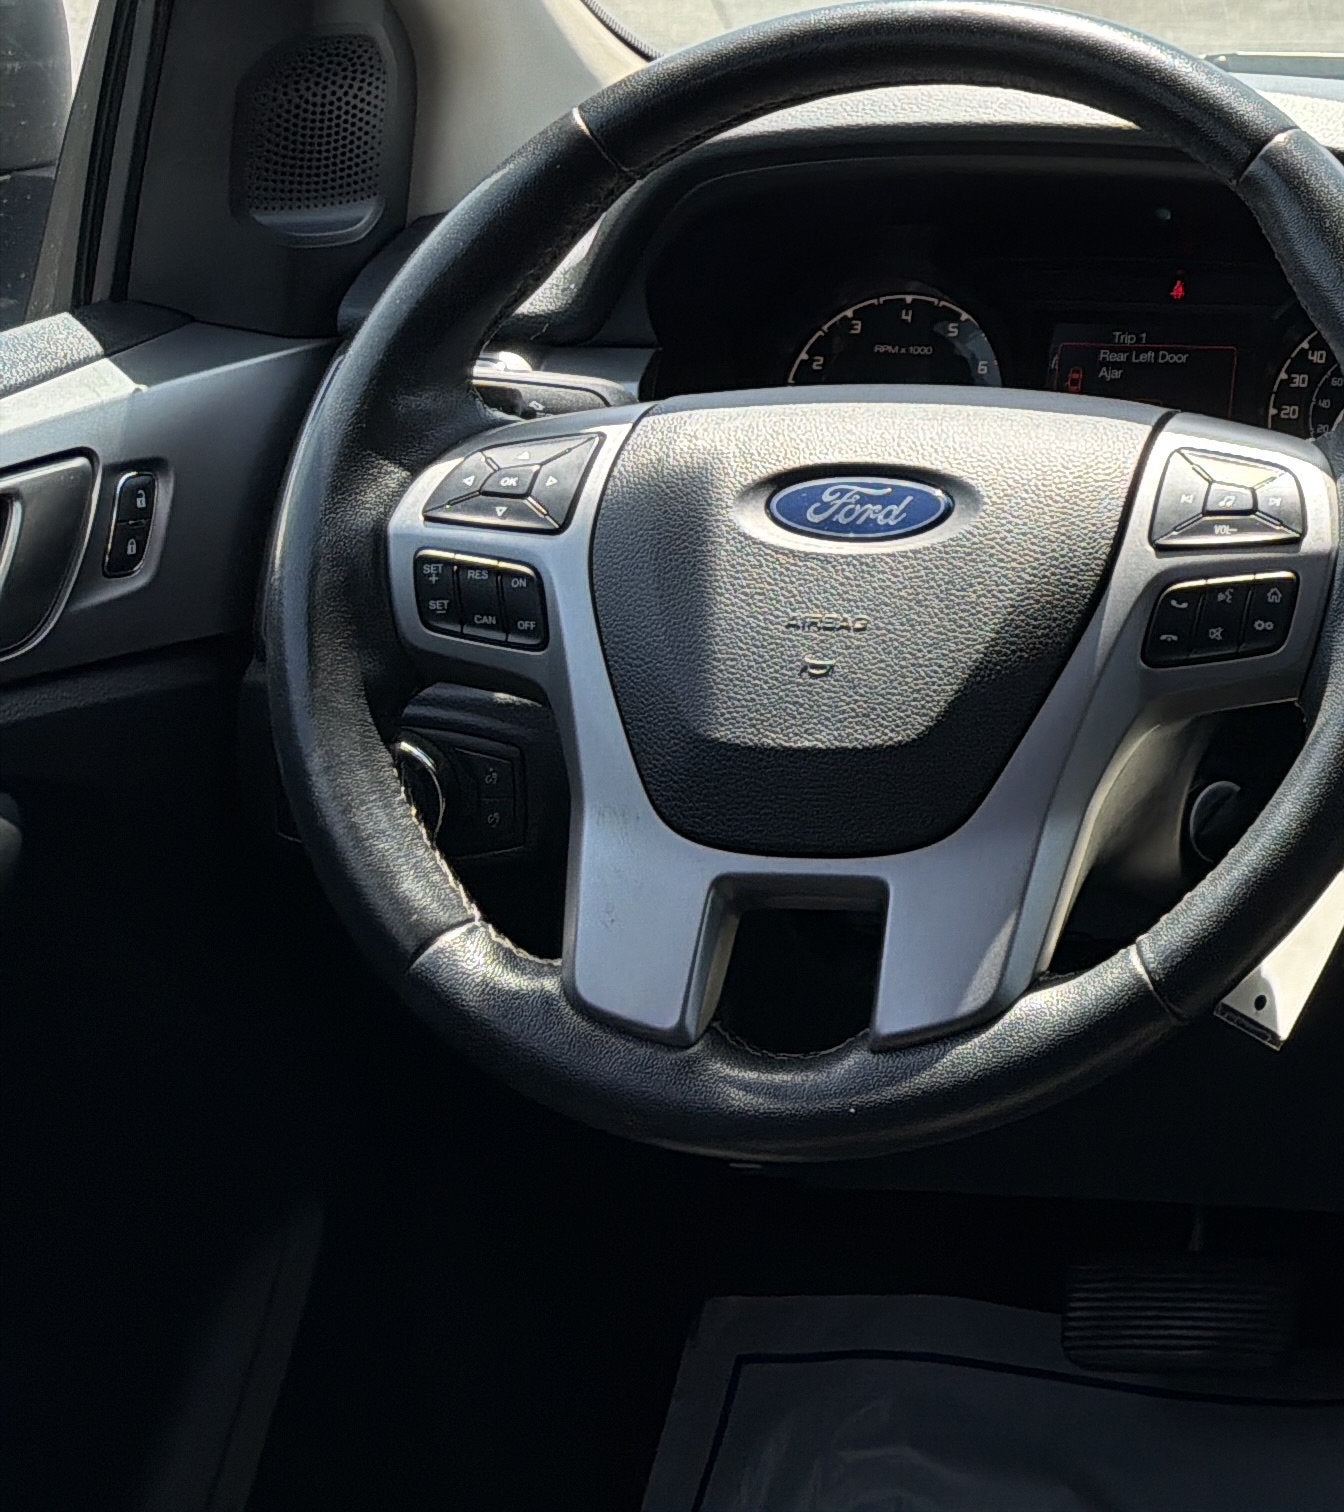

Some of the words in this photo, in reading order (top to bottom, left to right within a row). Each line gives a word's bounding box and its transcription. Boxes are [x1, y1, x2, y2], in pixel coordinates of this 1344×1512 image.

[901, 309, 913, 323] 4
[850, 320, 862, 334] 3
[947, 322, 959, 337] 5
[1112, 331, 1136, 345] Trip
[1140, 332, 1147, 343] 1
[874, 344, 899, 354] RPM
[908, 345, 933, 355] 1000
[1100, 349, 1129, 362] Rear
[1132, 349, 1155, 363] Left
[1158, 351, 1189, 363] Door
[812, 356, 824, 370] 2
[1308, 350, 1327, 364] 40
[977, 360, 988, 375] 6
[1098, 366, 1123, 380] Ajar
[1290, 374, 1308, 388] 30
[1318, 398, 1331, 408] 40
[1280, 405, 1299, 419] 20
[1316, 423, 1329, 433] 20
[500, 476, 518, 488] OK
[805, 483, 909, 526] Ford
[422, 563, 443, 575] SET
[467, 569, 489, 581] RES
[511, 577, 527, 588] ON
[428, 599, 449, 611] SET
[474, 614, 497, 626] CAN
[517, 619, 536, 631] OFF
